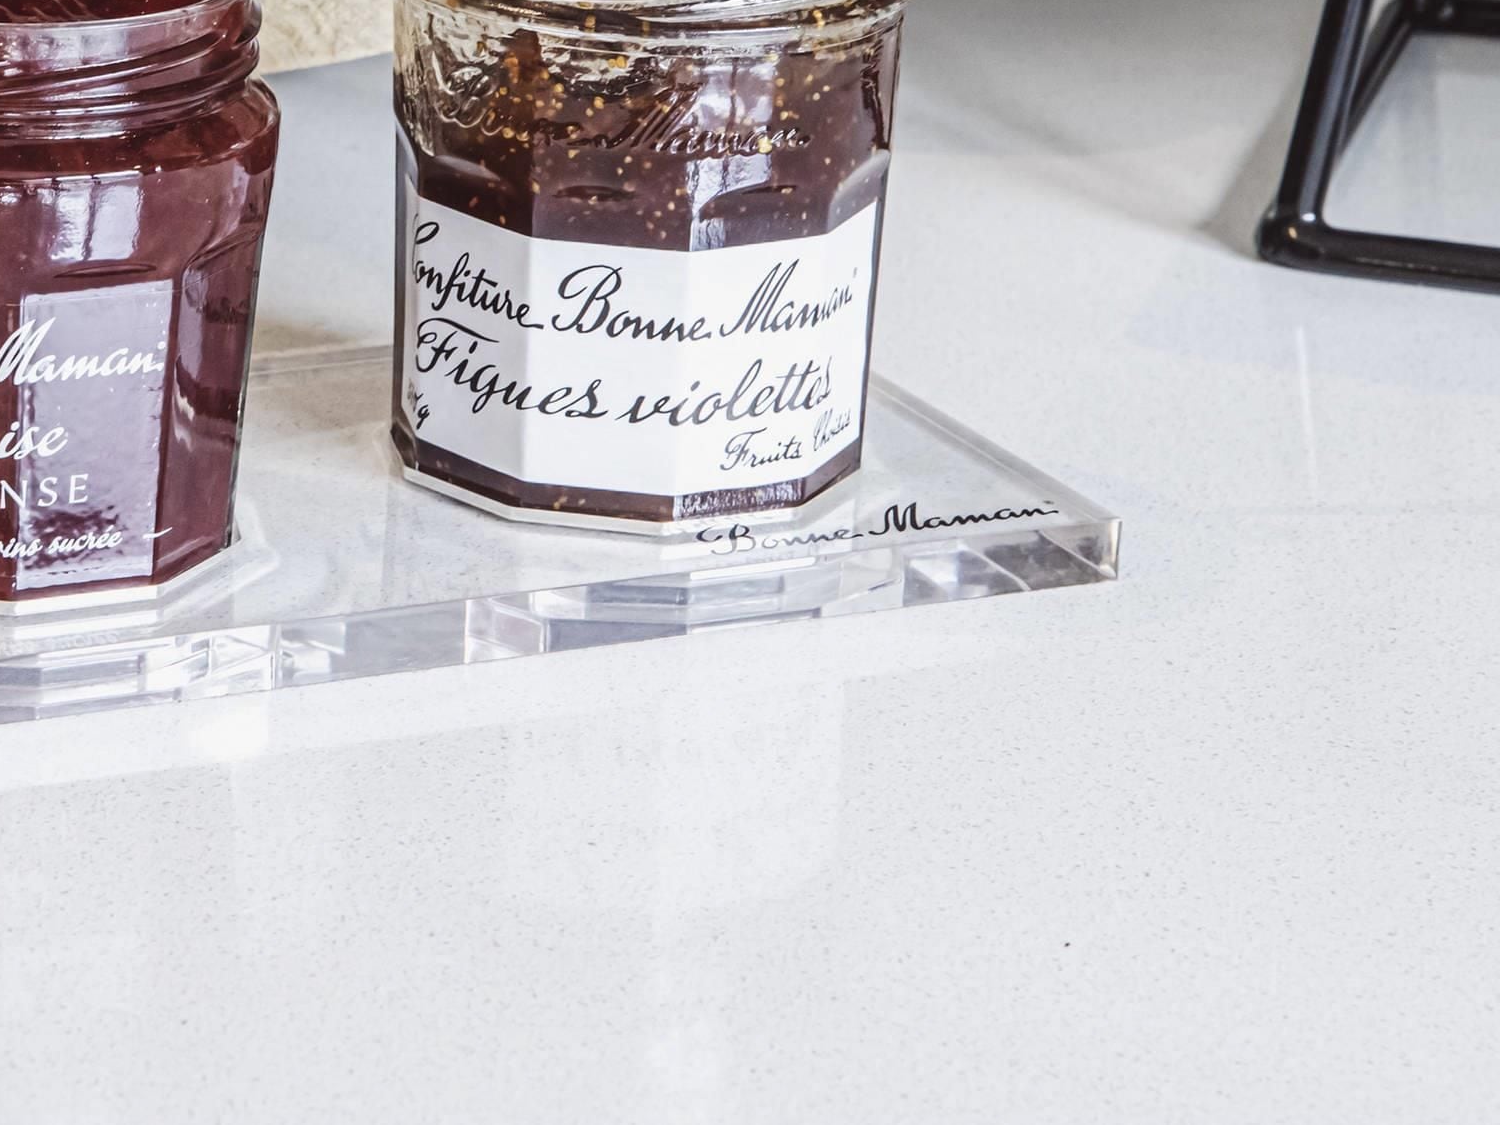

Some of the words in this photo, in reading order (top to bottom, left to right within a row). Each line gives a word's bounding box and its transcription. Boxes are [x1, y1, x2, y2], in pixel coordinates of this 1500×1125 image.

[412, 213, 544, 329] Confiture
[551, 264, 712, 342] Bonne
[416, 317, 608, 422] Figues
[615, 356, 833, 427] violettes
[719, 427, 802, 471] Fruits
[47, 525, 124, 555] sucrée
[696, 523, 864, 555] Bonne
